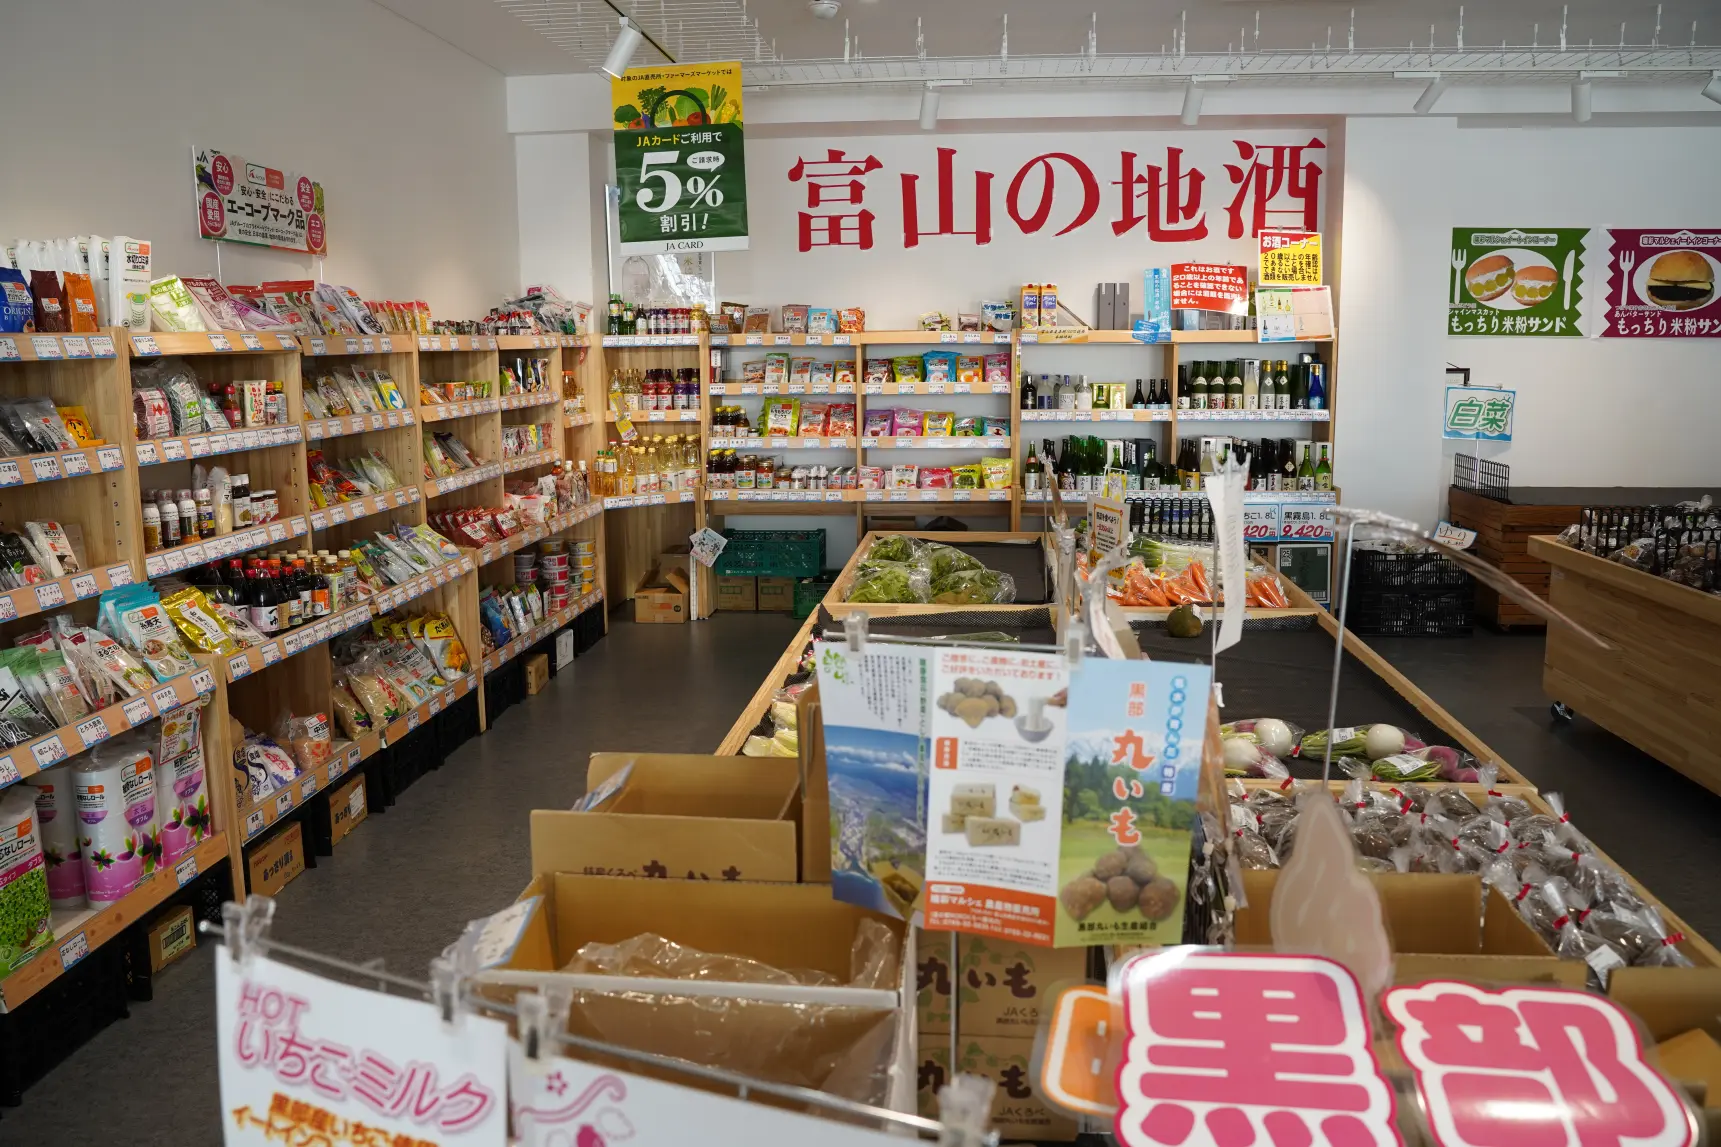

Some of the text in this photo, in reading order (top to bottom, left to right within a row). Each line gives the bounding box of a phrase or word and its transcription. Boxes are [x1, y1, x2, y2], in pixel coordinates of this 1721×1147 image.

[636, 131, 723, 147] JAカードご利用で
[215, 161, 229, 173] 安心
[636, 150, 725, 213] 5%
[788, 137, 1326, 253] 富山の地酒
[227, 199, 306, 230] エーコープマーク品
[664, 241, 704, 252] JA CARD
[1262, 235, 1318, 249] お酒コーナー
[1184, 266, 1234, 274] これはお酒です
[1173, 282, 1242, 291] ることを確認できない
[1449, 308, 1500, 316] シャインマスカット
[1451, 316, 1567, 333] もっちり米粉サンド
[1447, 396, 1514, 434] 白菜
[1282, 524, 1324, 538] 9,420
[1108, 682, 1155, 847] 黒部 丸いも
[136, 815, 149, 825] ダブル
[917, 956, 1037, 998] 丸いも
[235, 980, 311, 1026] HOT
[233, 1020, 497, 1131] いちごミルク
[917, 1060, 1032, 1099] 丸も
